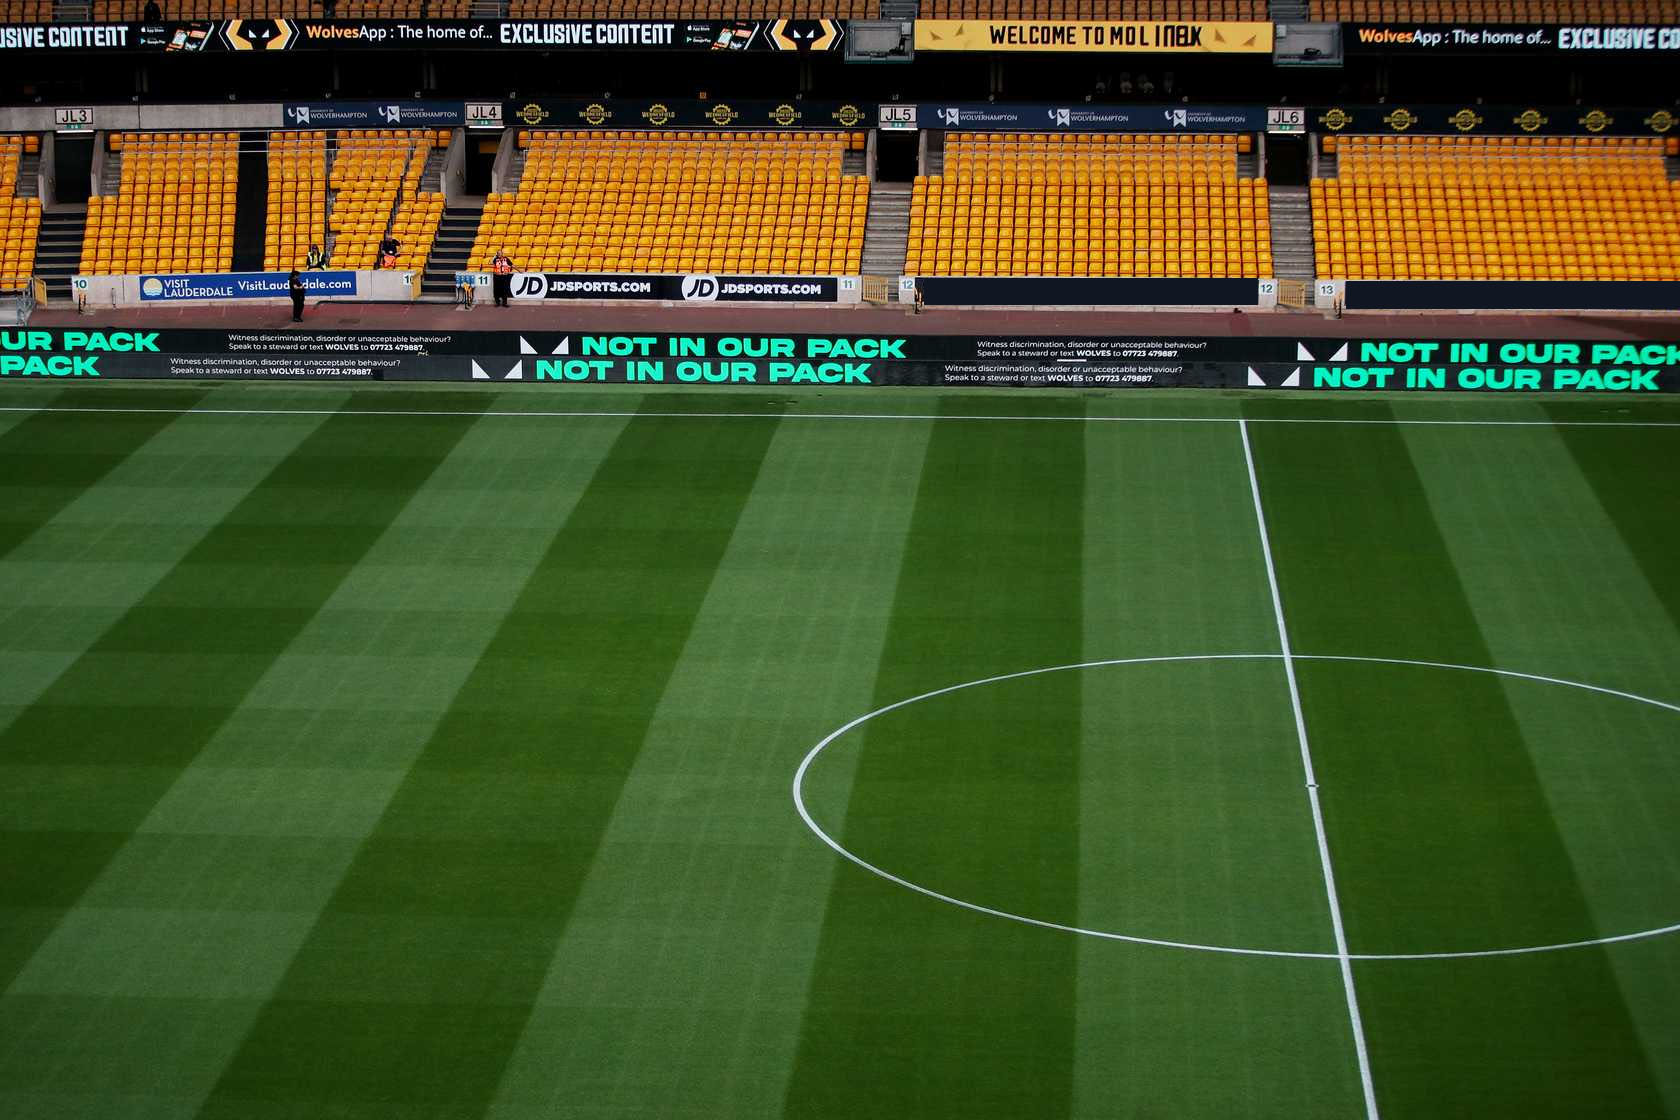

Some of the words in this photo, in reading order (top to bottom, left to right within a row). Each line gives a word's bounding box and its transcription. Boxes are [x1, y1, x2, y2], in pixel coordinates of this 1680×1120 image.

[49, 26, 129, 48] CONTENT
[306, 25, 387, 42] WolvesApp
[398, 25, 423, 39] The
[427, 25, 466, 39] home
[470, 25, 493, 39] of...
[501, 23, 593, 44] EXCLUSIVE
[596, 23, 675, 45] CONTENT
[990, 25, 1076, 45] WELCOME
[1082, 26, 1104, 45] TO
[1359, 28, 1441, 46] WolvesApp
[1452, 28, 1480, 44] The
[1482, 29, 1523, 45] home
[1526, 29, 1551, 45] of...
[1558, 28, 1656, 49] EXCLUSIVE
[62, 110, 87, 122] JL3
[400, 111, 458, 119] WOLVERHAMPTON
[472, 105, 497, 118] JL4
[886, 109, 911, 121] JL5
[1273, 111, 1299, 124] JL6
[1070, 114, 1129, 122] WOLVERHAMPTON
[1187, 115, 1246, 123] WOLVERHAMPTON
[74, 279, 88, 289] 10
[164, 279, 190, 288] VISIT
[238, 277, 352, 291] VisitLauddale.com
[478, 276, 488, 285] 11
[516, 277, 544, 296] JD
[843, 280, 853, 289] 11
[902, 280, 914, 289] 12
[164, 286, 234, 298] LAUDERDALE
[549, 281, 651, 293] JDSPORTS.COM
[687, 279, 715, 298] JD
[720, 284, 822, 295] JDSPORTS.COM
[1260, 284, 1273, 294] 12
[1320, 285, 1334, 295] 13
[0, 331, 52, 350] UR
[64, 332, 161, 351] PACK
[582, 337, 657, 356] NOT
[670, 338, 705, 356] IN
[718, 338, 795, 357] OUR
[808, 339, 906, 358] PACK
[1361, 343, 1439, 362] NOT
[1451, 344, 1488, 362] IN
[1500, 344, 1580, 363] OUR
[0, 356, 99, 376] PACK
[537, 360, 613, 380] NOT
[627, 361, 663, 381] IN
[677, 361, 756, 382] OUR
[770, 363, 872, 383] PACK
[978, 365, 1036, 373] discrimination,
[1082, 366, 1136, 374] unacceptable
[945, 374, 969, 382] Speak
[1314, 367, 1394, 387] NOT
[1407, 368, 1445, 388] IN
[1458, 368, 1541, 389] OUR
[1554, 369, 1660, 390] PACK
